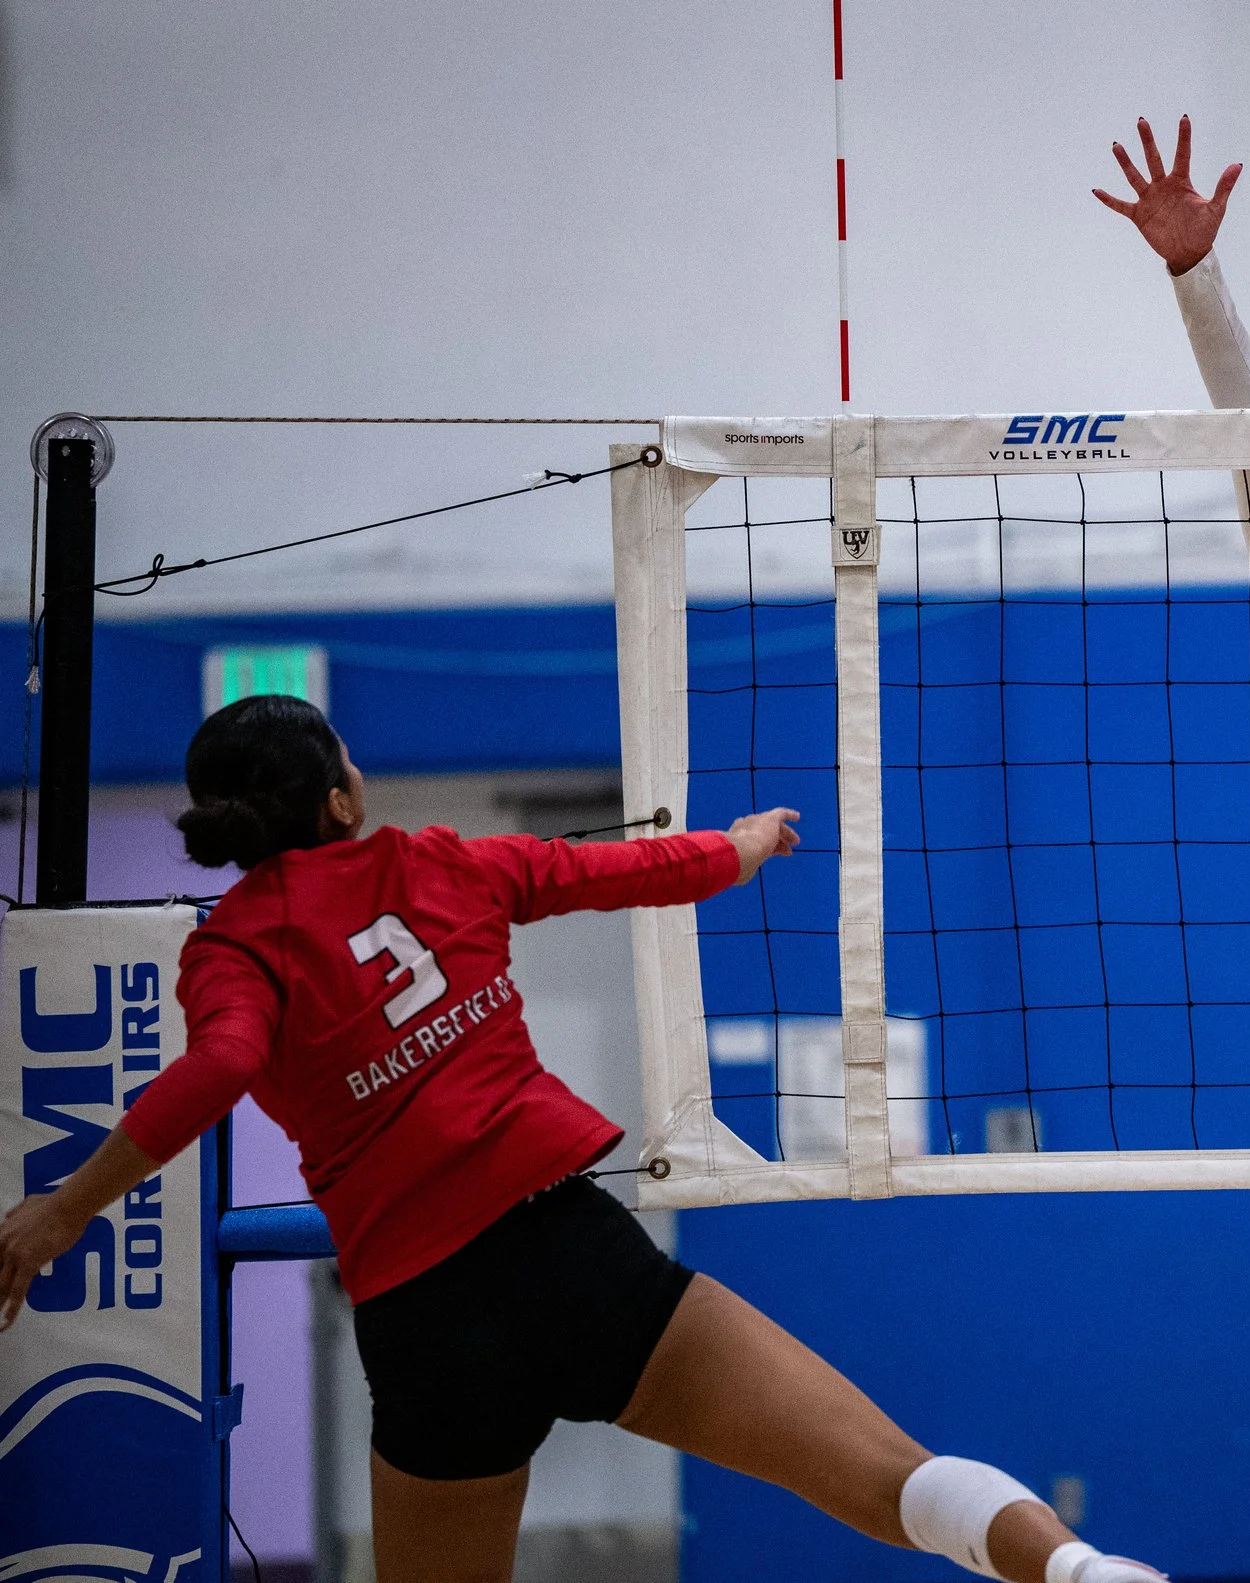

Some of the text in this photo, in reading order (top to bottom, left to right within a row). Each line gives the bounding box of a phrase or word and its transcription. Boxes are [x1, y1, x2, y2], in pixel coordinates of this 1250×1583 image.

[724, 433, 804, 446] sports imports
[1002, 414, 1126, 444] SMC
[988, 448, 1131, 460] VOLLEYBALL
[347, 911, 449, 1031] 3
[345, 975, 513, 1101] BAKERSFIELD
